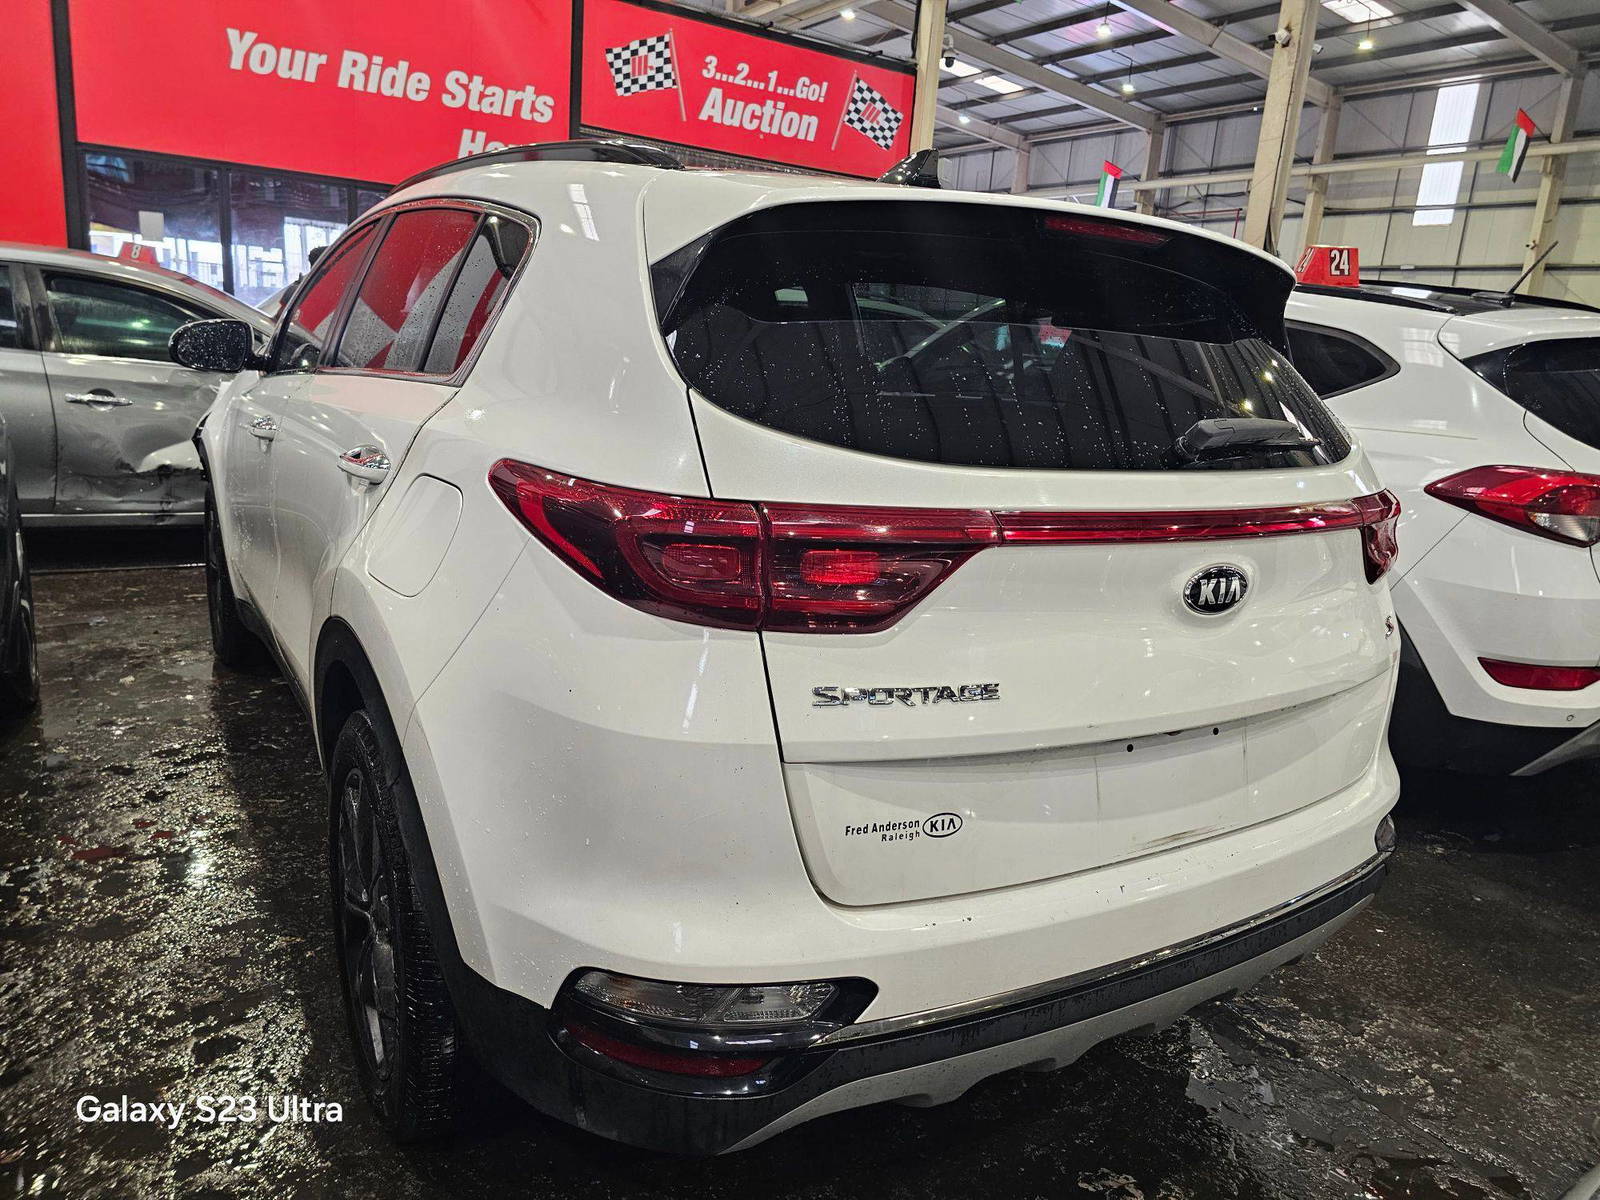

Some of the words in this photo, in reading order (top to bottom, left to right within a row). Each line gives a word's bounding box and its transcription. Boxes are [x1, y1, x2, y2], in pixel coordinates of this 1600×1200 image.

[226, 28, 327, 83] Your
[337, 50, 431, 102] Ride
[441, 71, 555, 124] Starts
[701, 55, 828, 103] 3...2...1...Go!
[698, 87, 819, 142] Auction
[131, 244, 141, 259] 8
[1330, 249, 1349, 275] 24
[1198, 576, 1241, 605] KIA
[812, 683, 1000, 706] SPORTAGE
[845, 824, 869, 837] Fred
[872, 820, 920, 832] Anderson
[929, 817, 957, 833] KIA
[881, 830, 920, 842] Raleigh
